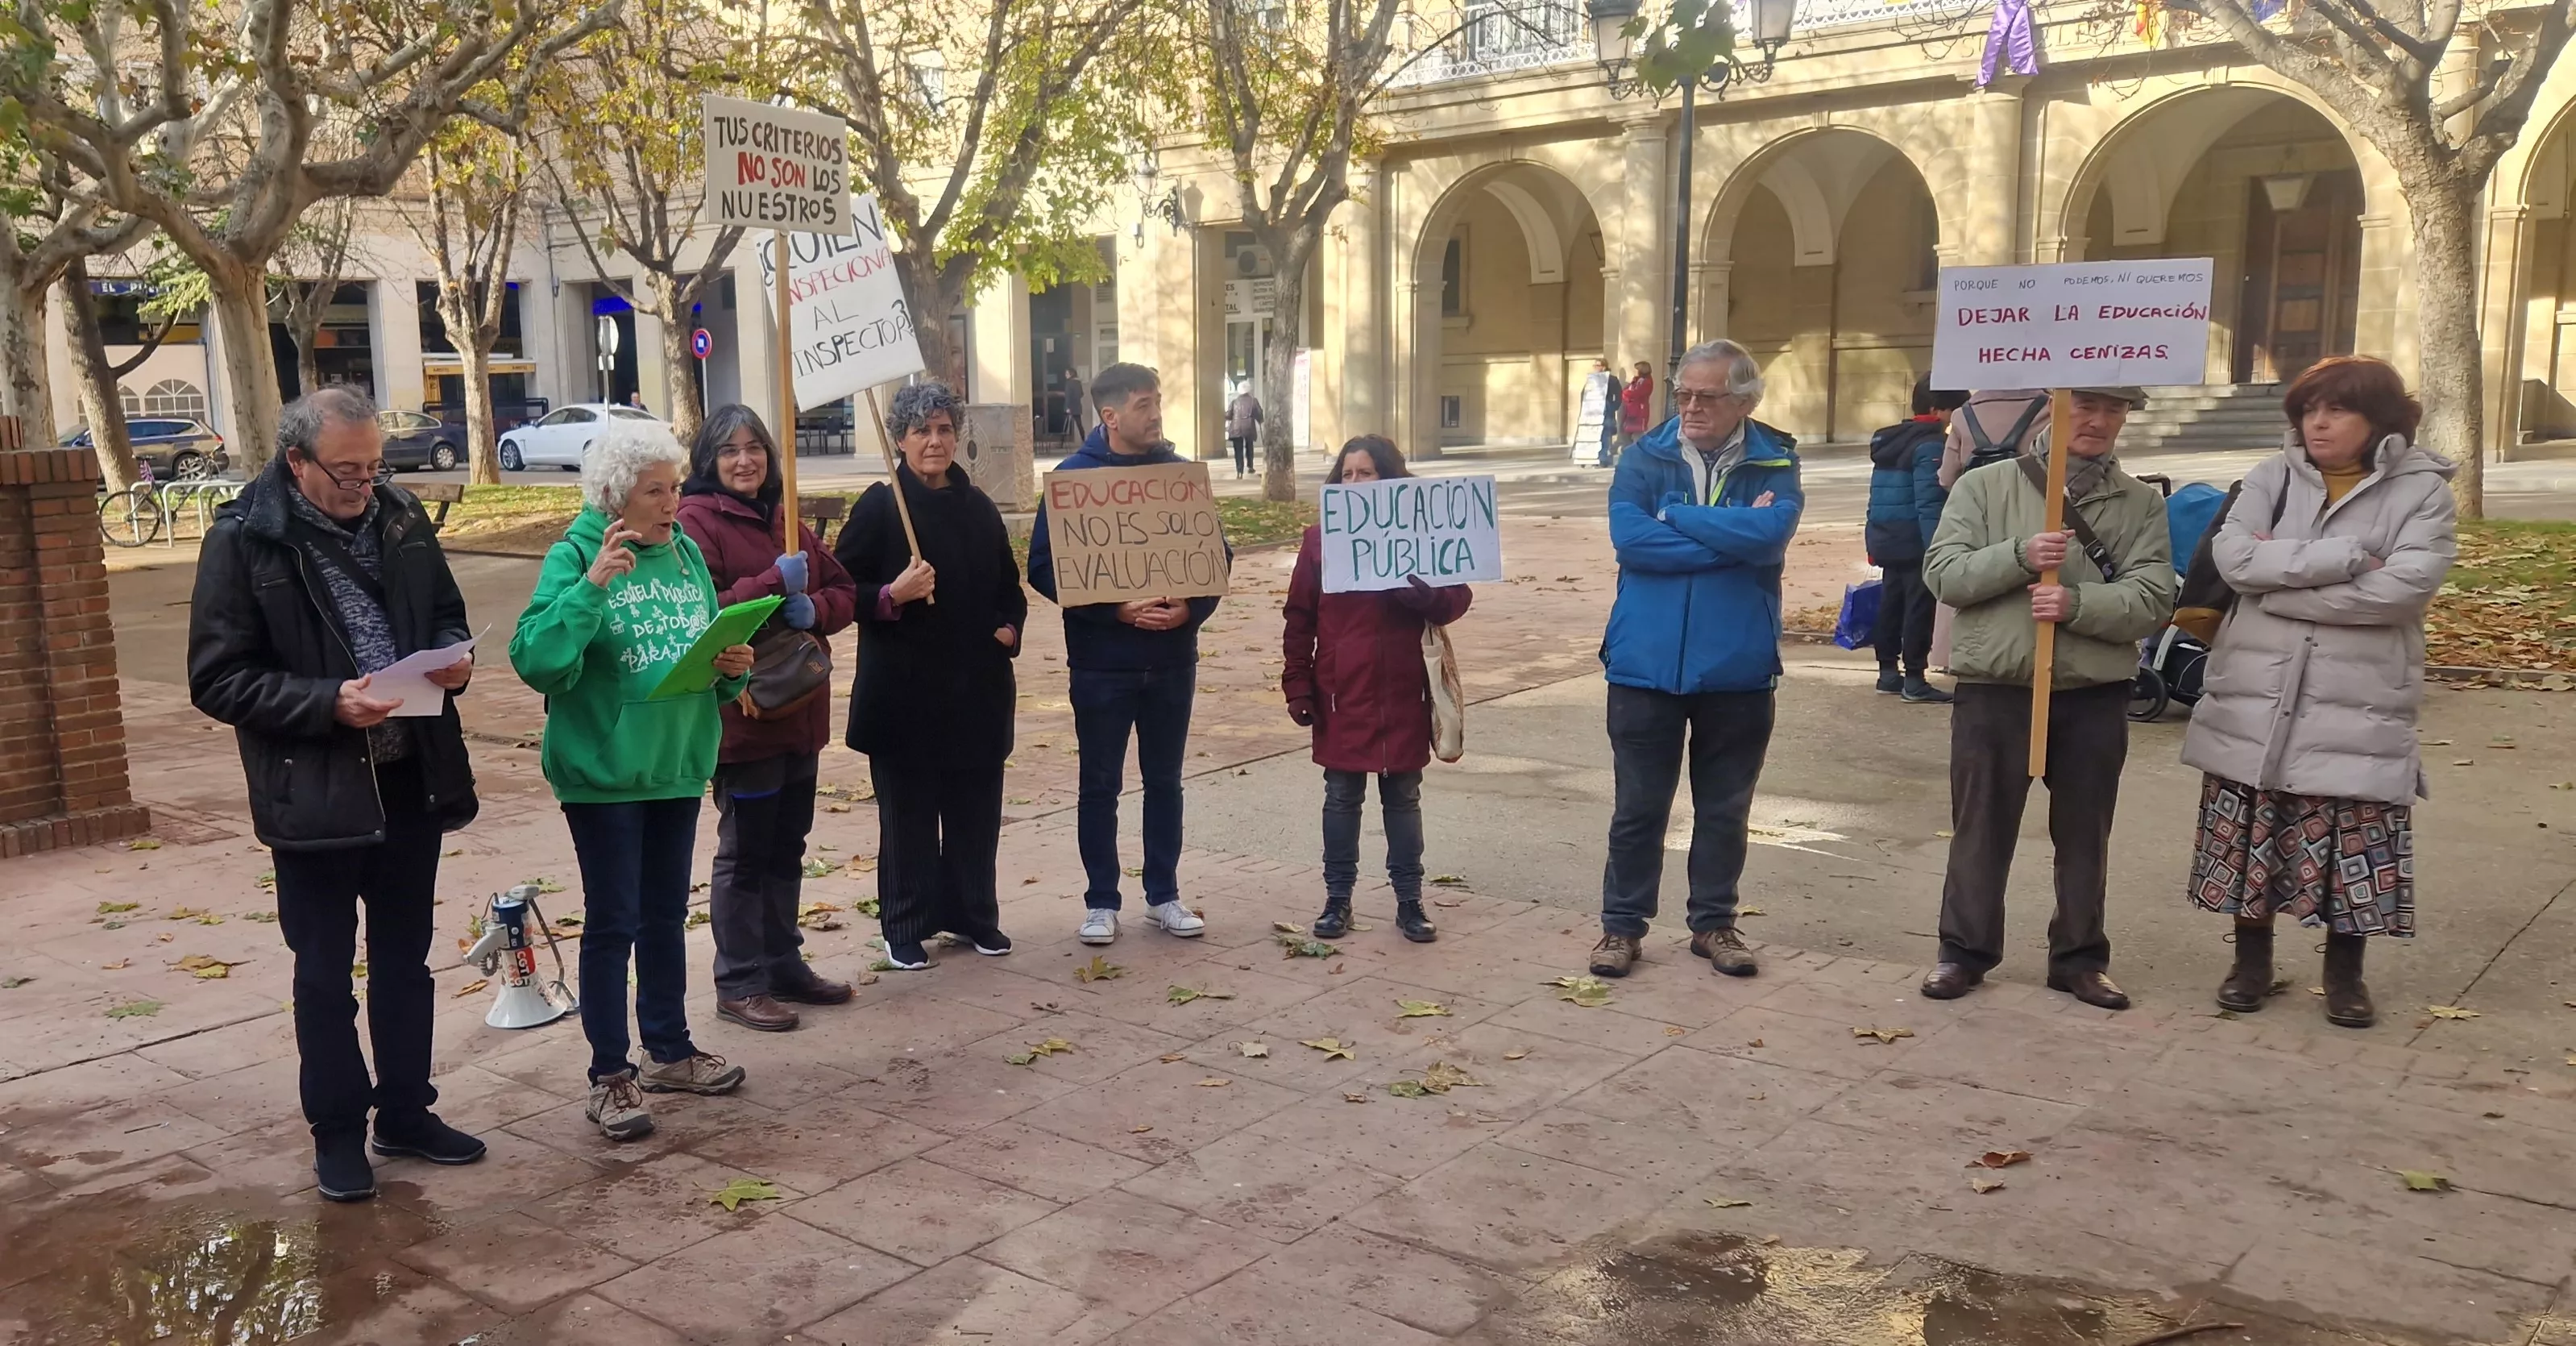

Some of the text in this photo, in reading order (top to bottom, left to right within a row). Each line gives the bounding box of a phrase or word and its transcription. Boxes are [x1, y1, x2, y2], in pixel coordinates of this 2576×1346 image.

[714, 116, 843, 164] TUS CRITERIOS
[737, 152, 841, 196] NO SON LOS
[721, 189, 836, 226] NUESTROS
[102, 281, 116, 293] EL
[771, 247, 893, 305] NSPECIONA
[1954, 279, 1998, 291] PORQUE
[2018, 279, 2036, 290] NO
[2118, 272, 2131, 282] NI
[2136, 273, 2204, 284] QUEREMOS
[813, 299, 859, 331] AL
[1958, 306, 2031, 326] DEJAR
[2054, 304, 2079, 322] LA
[1979, 347, 2051, 363] HECHA
[1051, 472, 1209, 509] EDUCACIÓN
[1324, 477, 1495, 534] EDUCACIÓN
[1064, 509, 1214, 548] NO ES SOLO
[1057, 541, 1229, 590] EVALUACIÓN
[1351, 530, 1476, 582] PÚBLICA
[608, 581, 707, 609] ESCUELA PÚBLICA
[632, 619, 654, 638] DE
[628, 643, 671, 670] PARA
[516, 951, 530, 974] CGT
[508, 977, 529, 987] CGT
